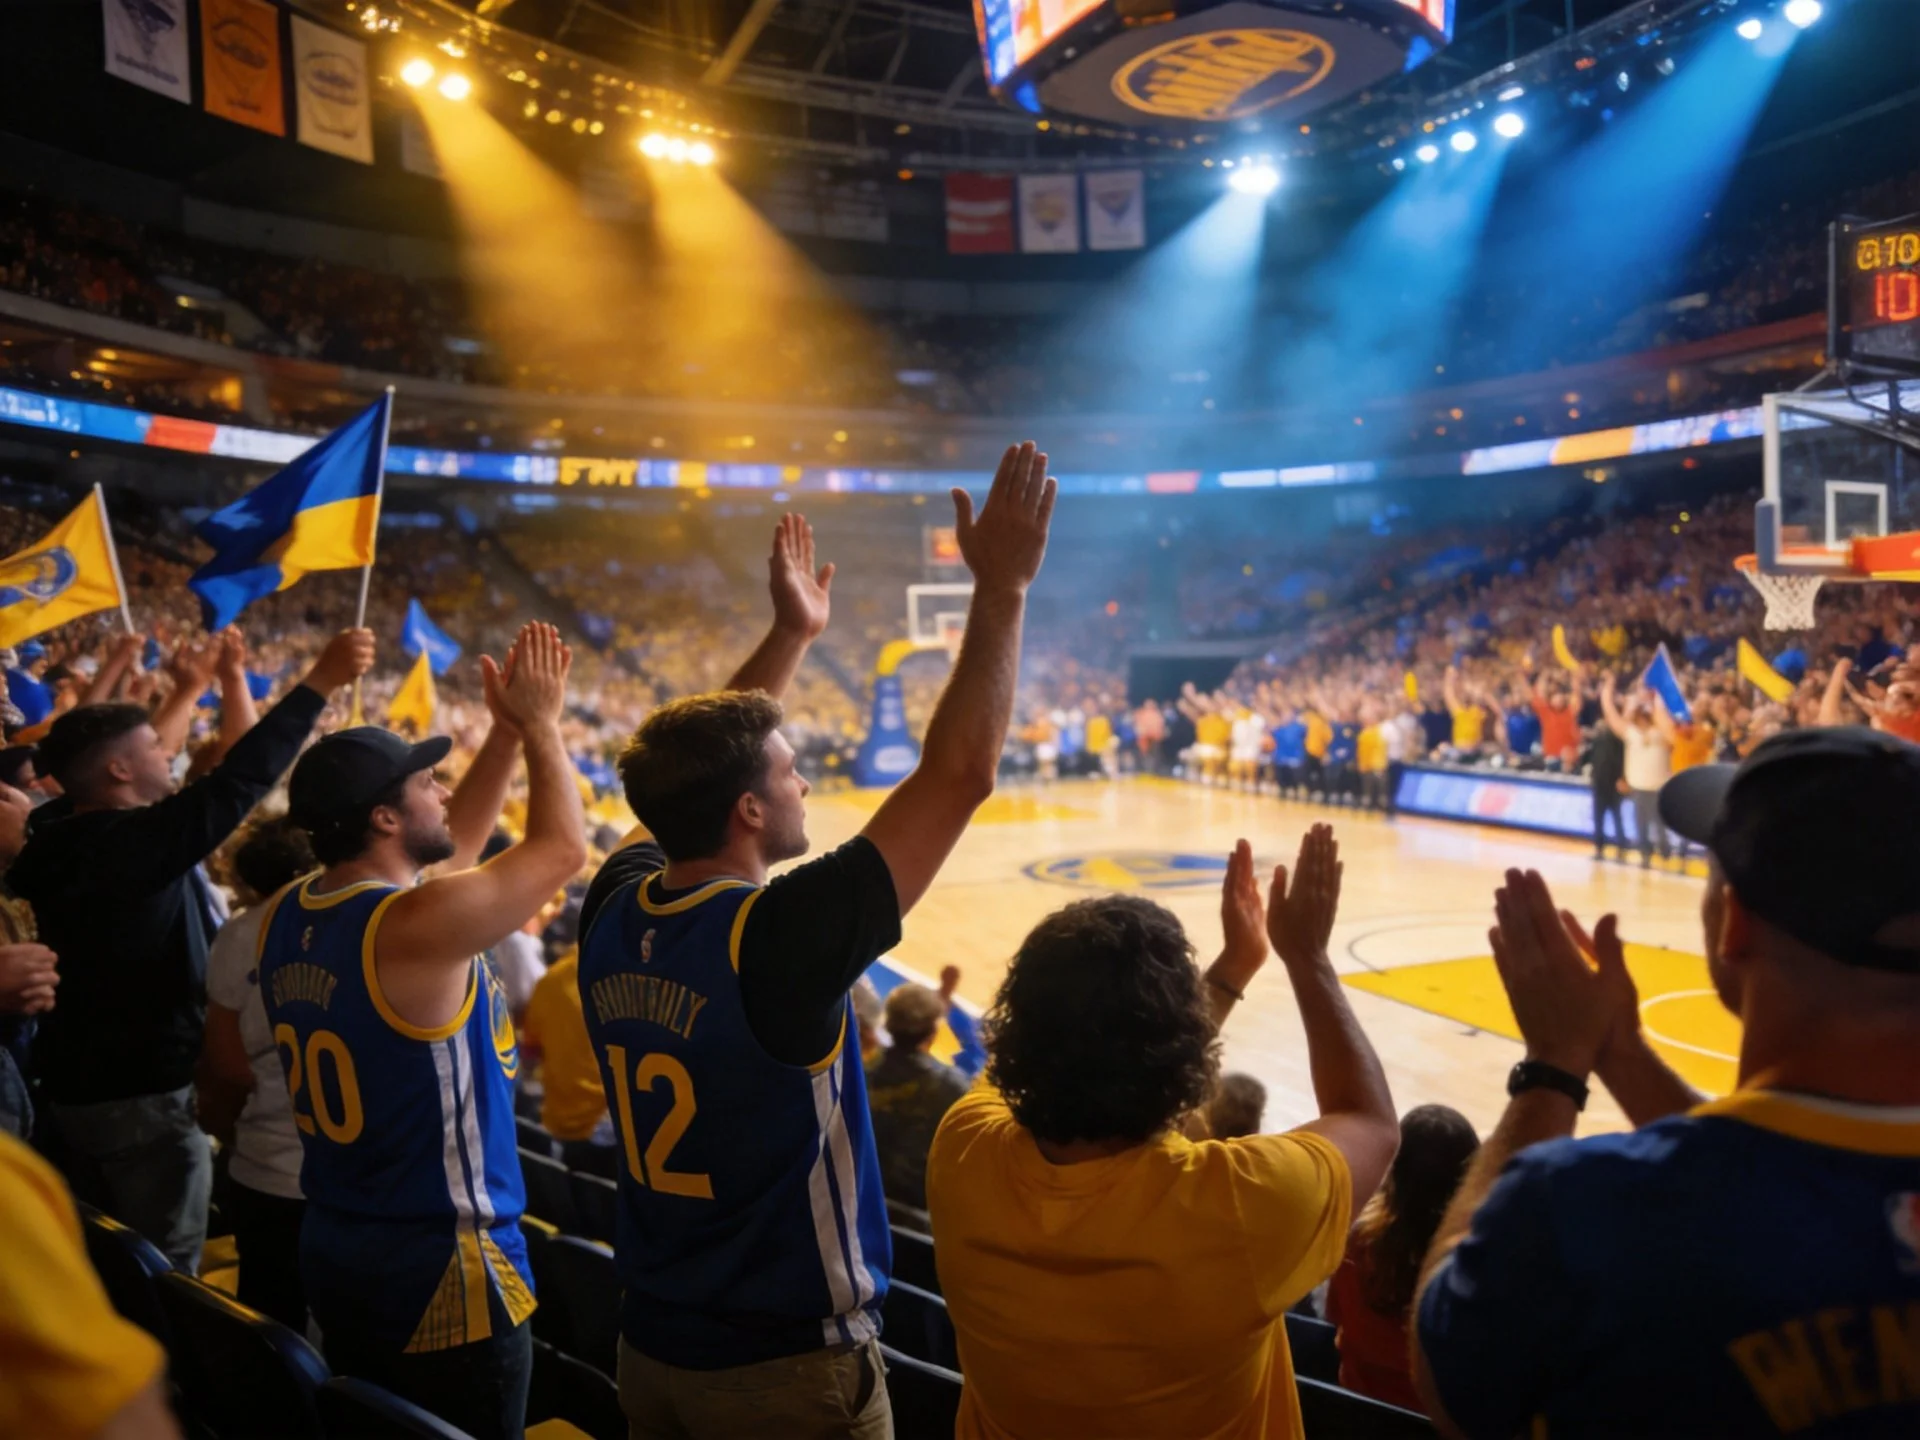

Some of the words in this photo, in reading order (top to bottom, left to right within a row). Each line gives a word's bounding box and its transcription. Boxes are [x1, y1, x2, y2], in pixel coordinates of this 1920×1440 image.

[1876, 272, 1918, 321] 10
[274, 1023, 364, 1144] 20
[605, 1044, 716, 1200] 12
